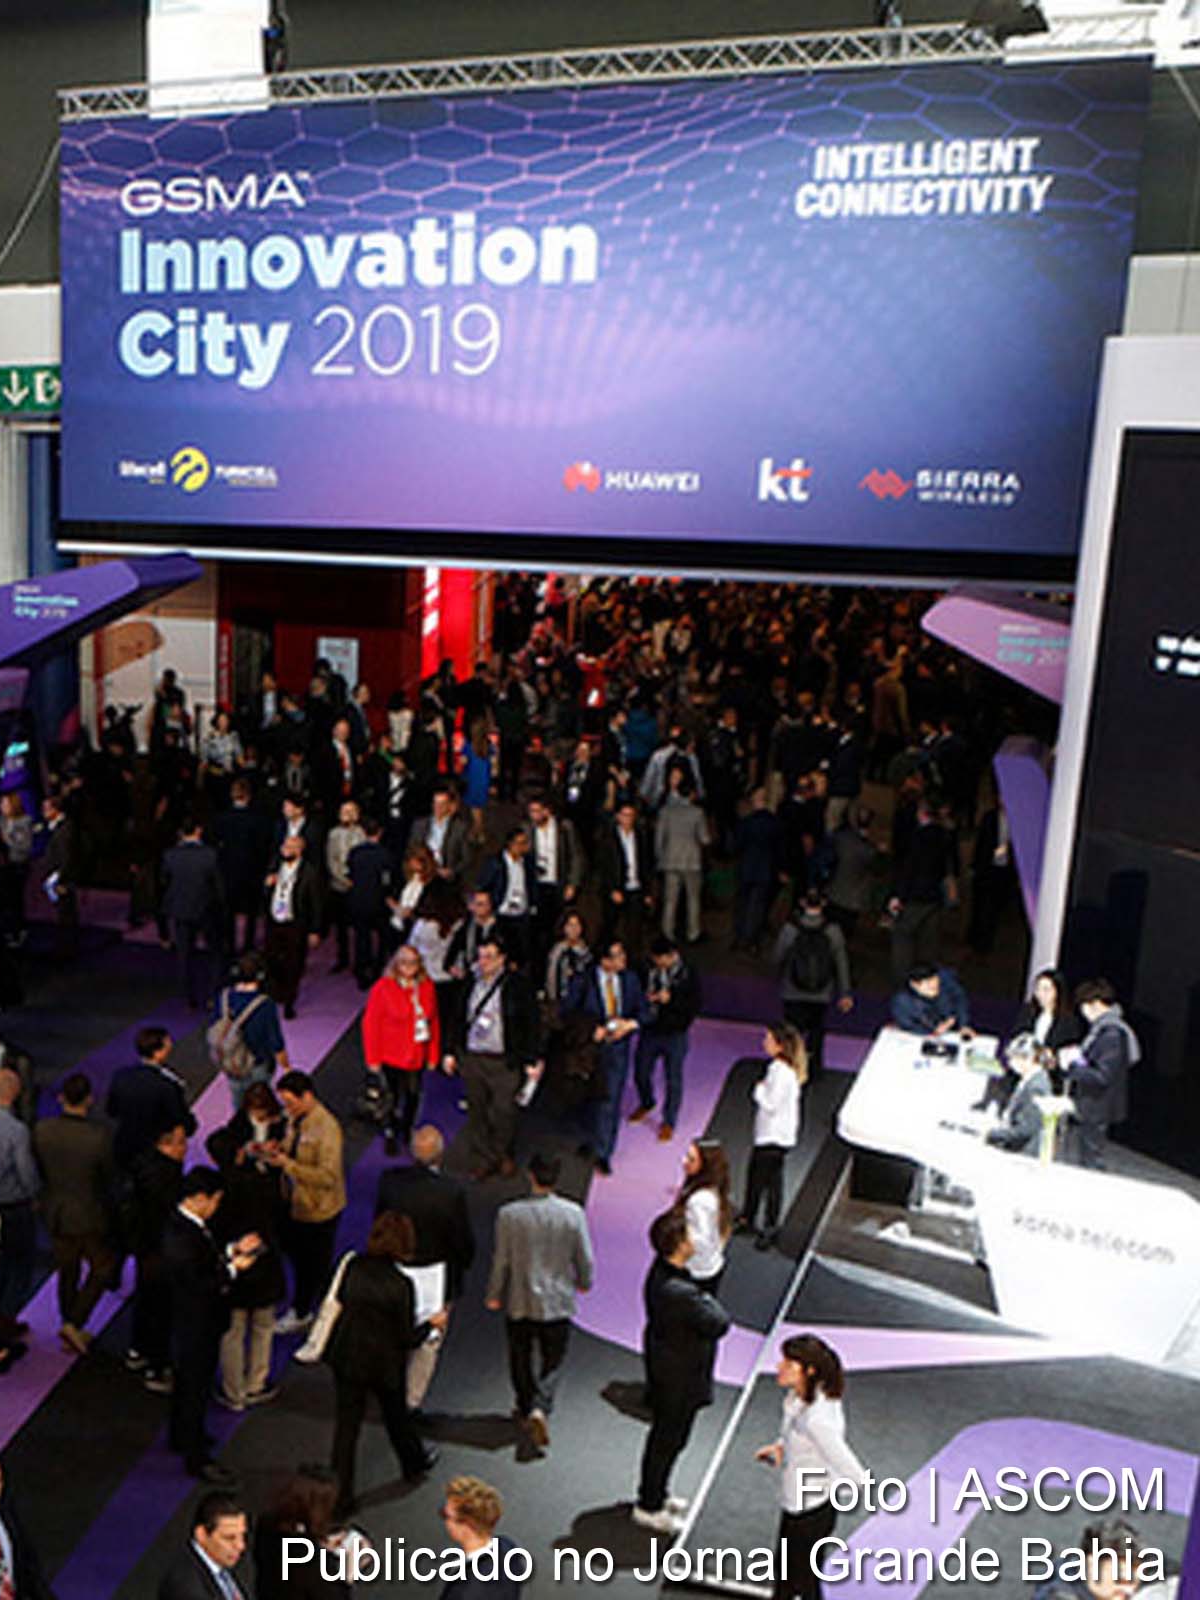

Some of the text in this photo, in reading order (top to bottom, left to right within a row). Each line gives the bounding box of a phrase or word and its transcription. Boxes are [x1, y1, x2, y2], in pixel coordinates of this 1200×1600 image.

[813, 137, 1041, 181] INTELLIGENT
[794, 175, 1054, 219] CONNECTIVITY
[119, 212, 599, 294] Innovation
[118, 303, 501, 390] City 2019
[604, 470, 701, 493] HUAWEI
[757, 457, 814, 503] kt
[916, 469, 1022, 491] SIERRA
[1011, 1208, 1176, 1265] korea telecom
